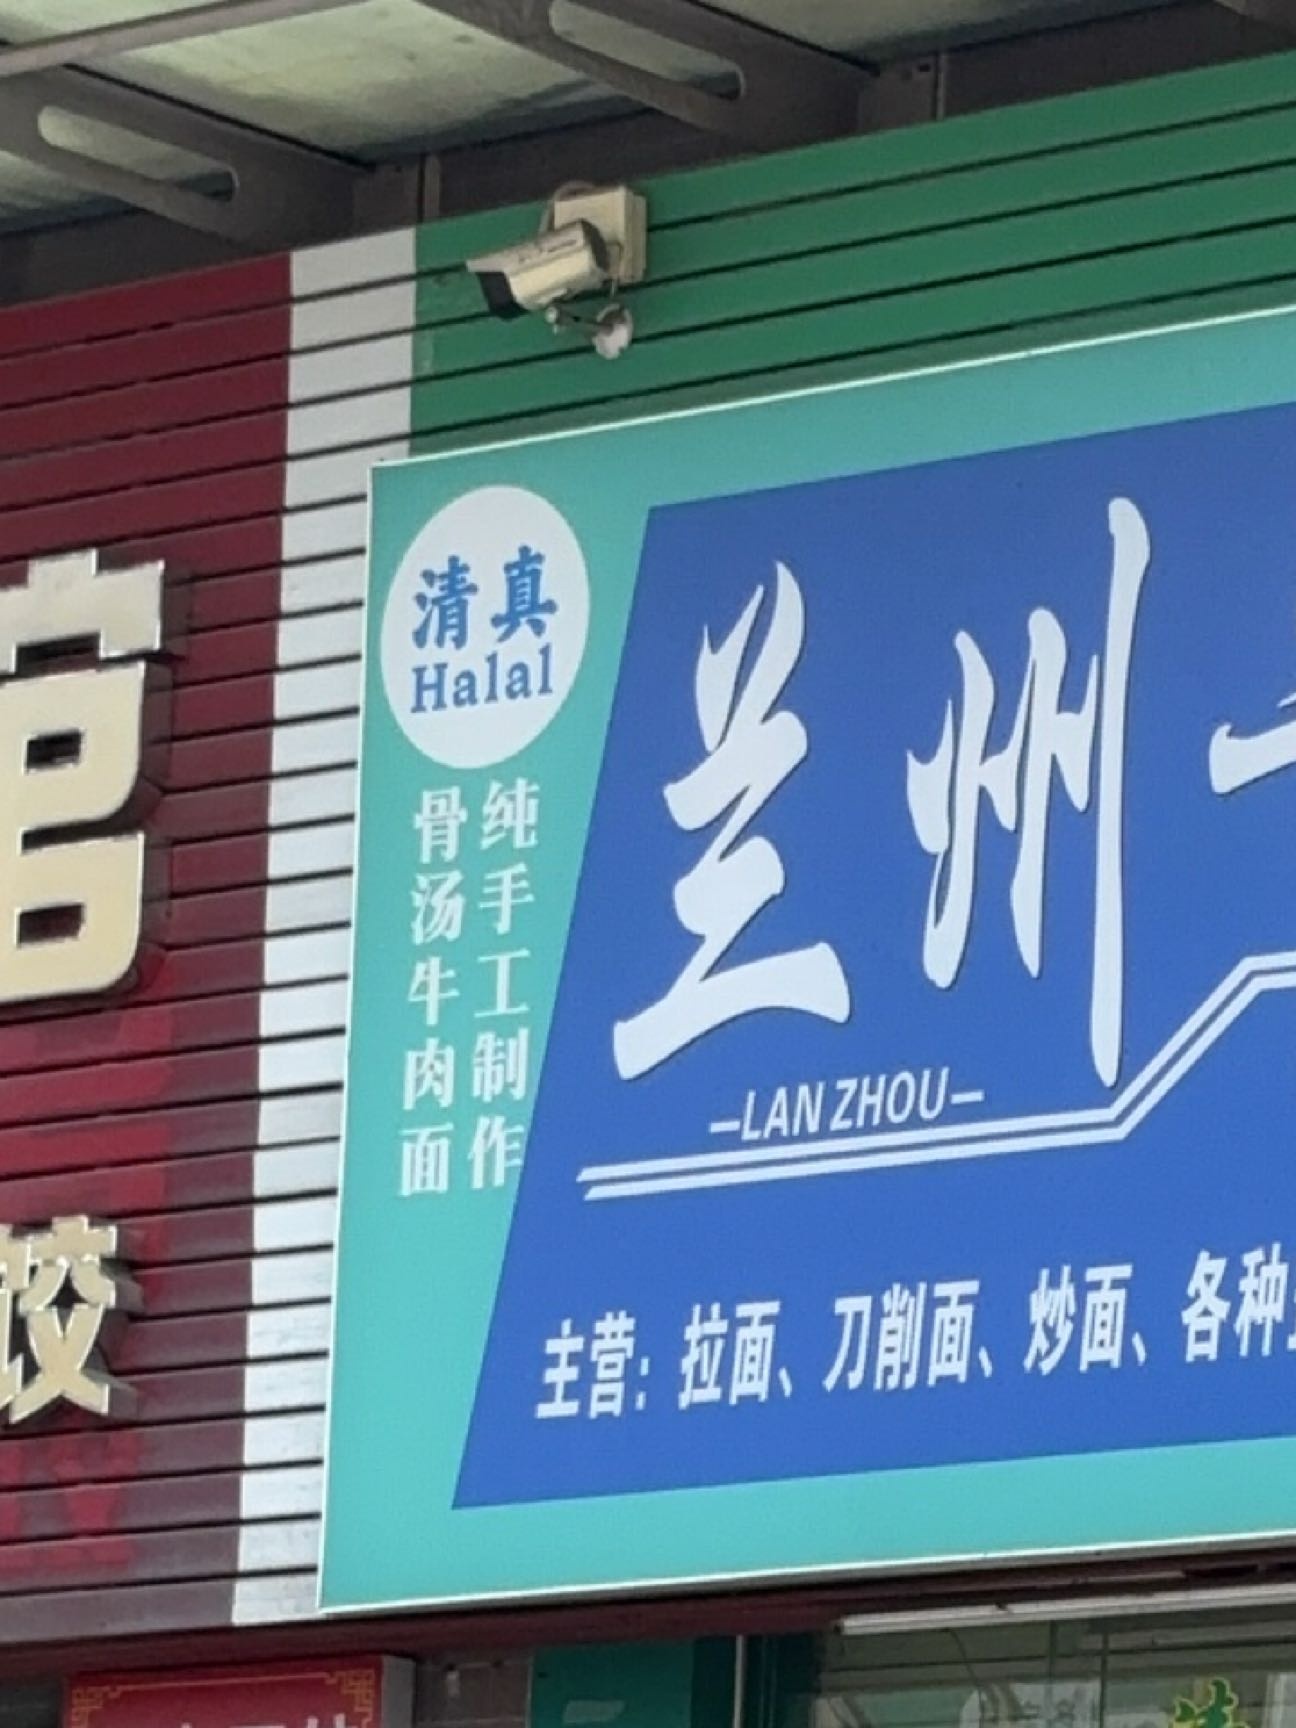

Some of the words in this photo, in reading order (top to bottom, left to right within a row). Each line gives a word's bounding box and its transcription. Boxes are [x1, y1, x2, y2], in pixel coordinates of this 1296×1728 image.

[411, 646, 555, 714] Halal
[412, 547, 557, 651] 清真
[400, 791, 468, 1196] 骨汤牛肉面
[470, 778, 540, 1190] 纯手工制作
